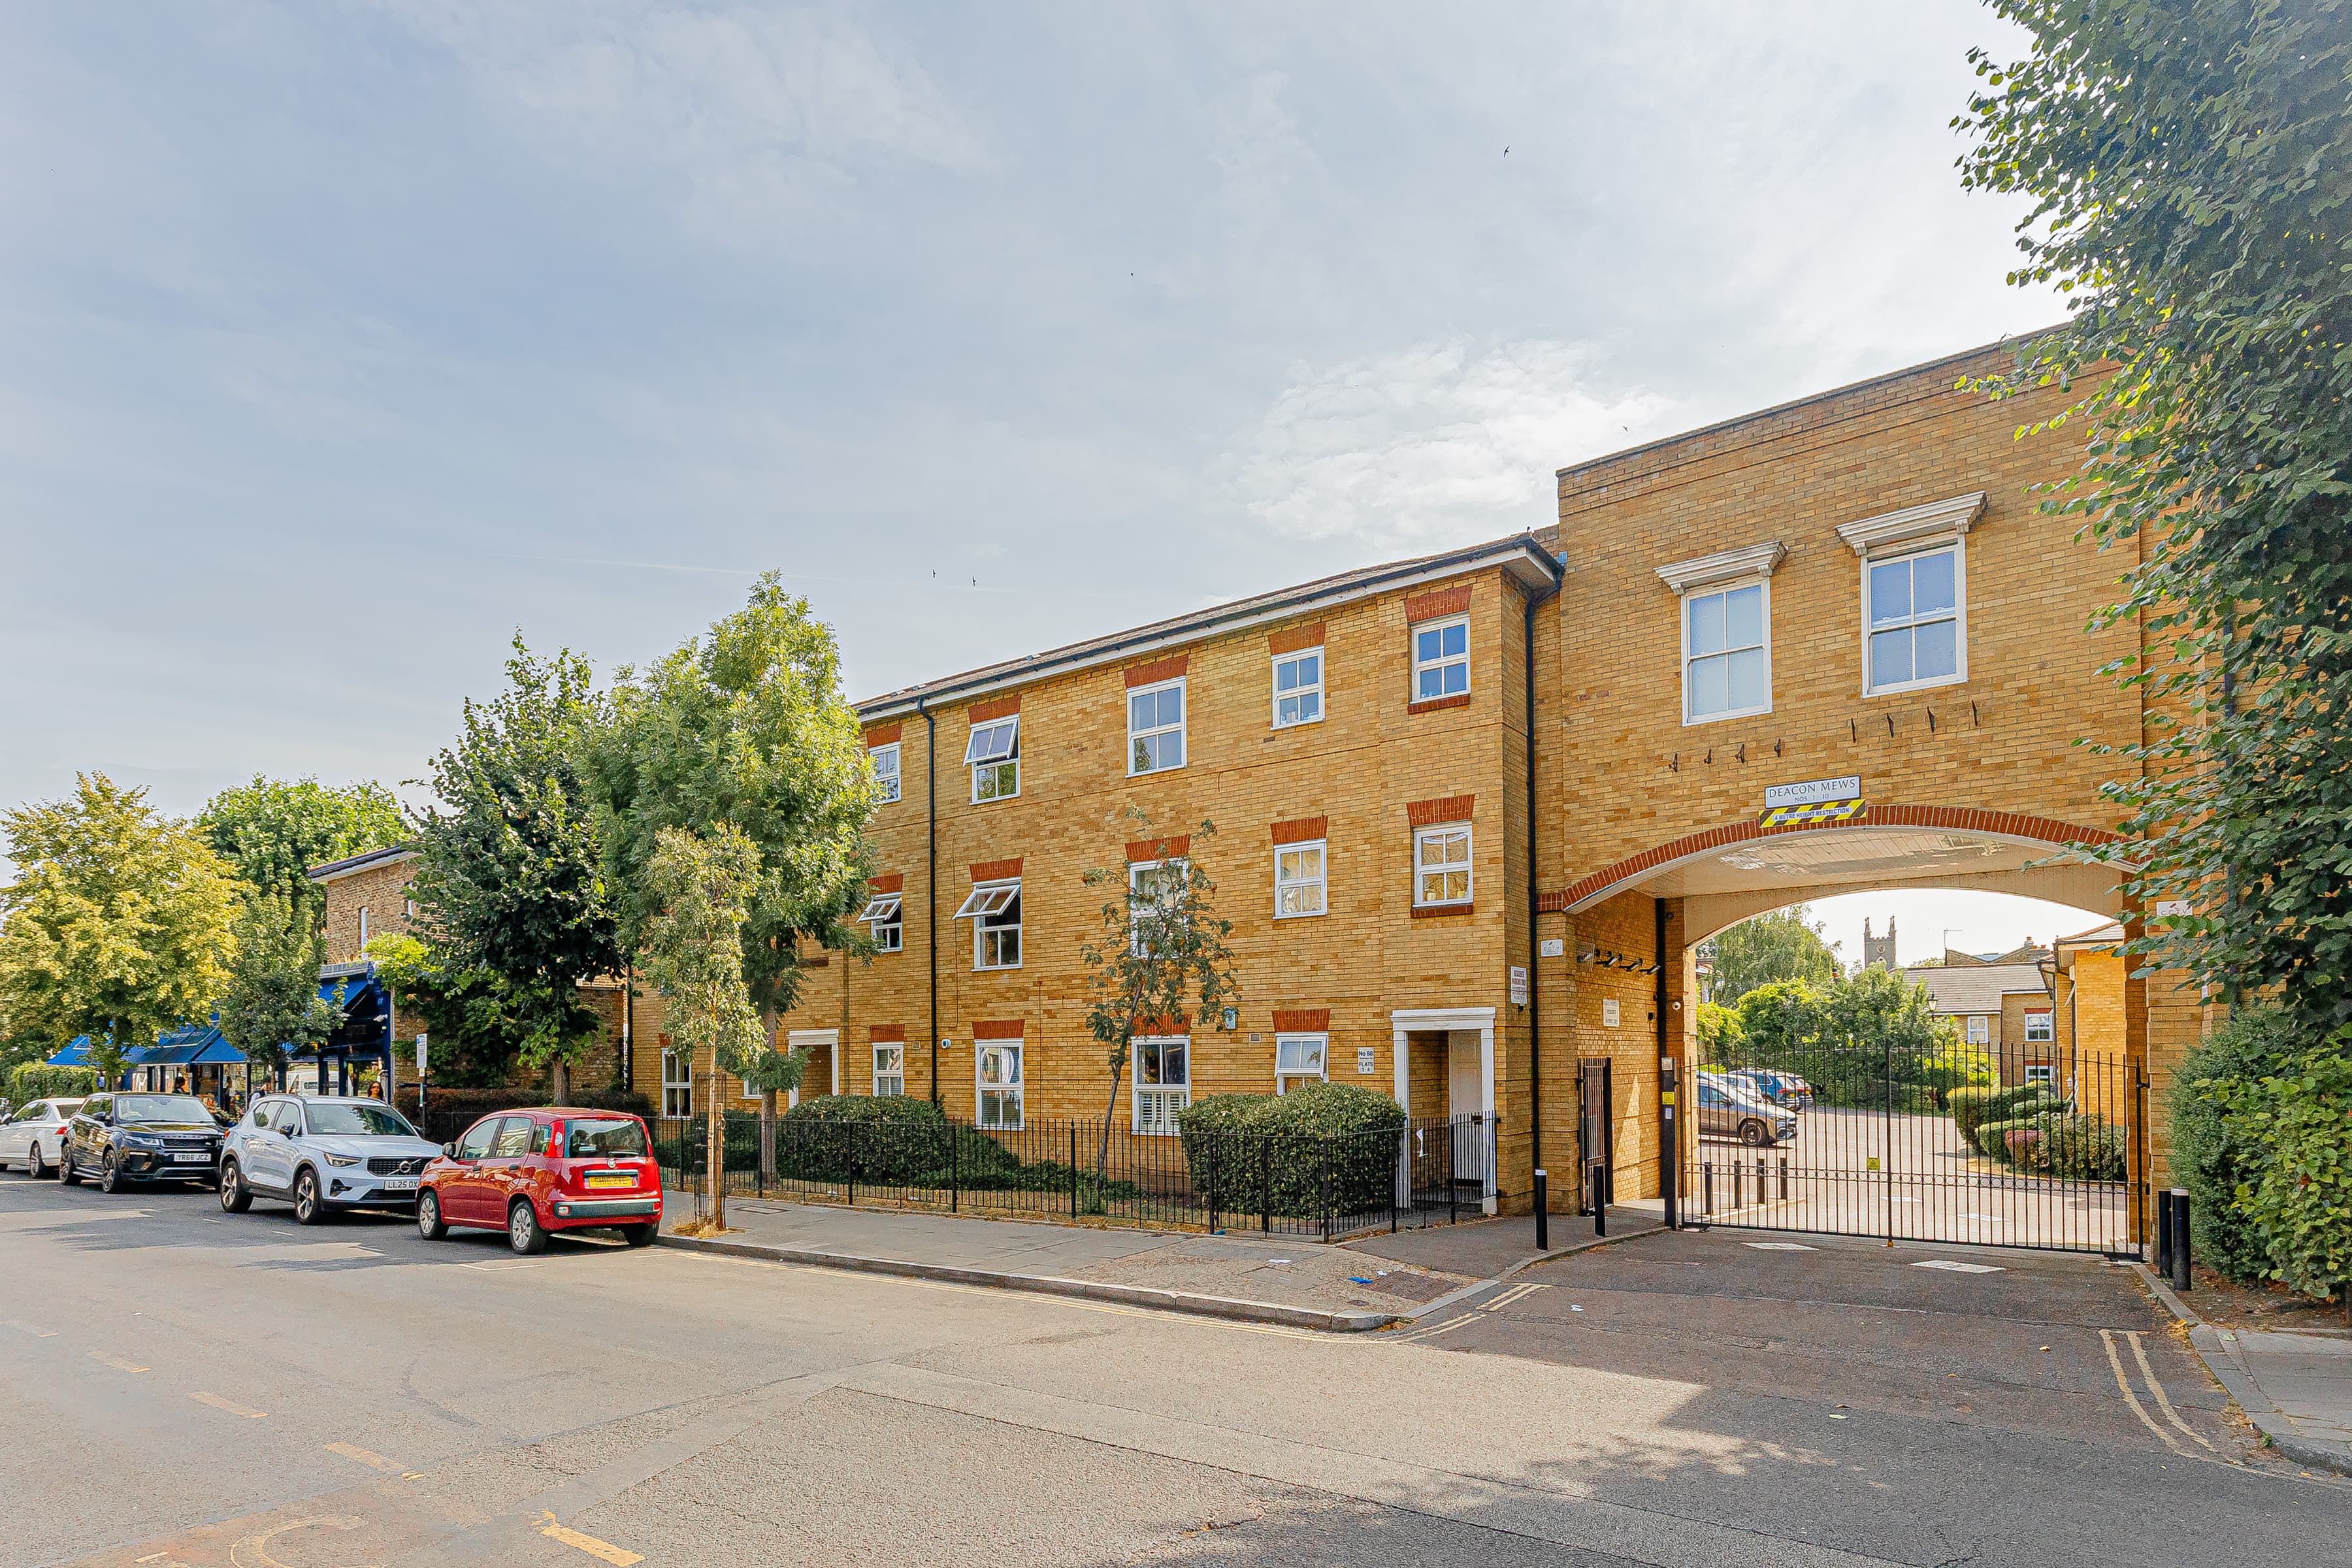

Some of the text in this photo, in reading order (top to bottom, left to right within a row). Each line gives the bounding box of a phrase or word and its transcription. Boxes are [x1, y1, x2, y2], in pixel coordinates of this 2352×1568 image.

[1769, 779, 1855, 798] DEACON MEWS
[1816, 807, 1850, 816] RESTRICTION
